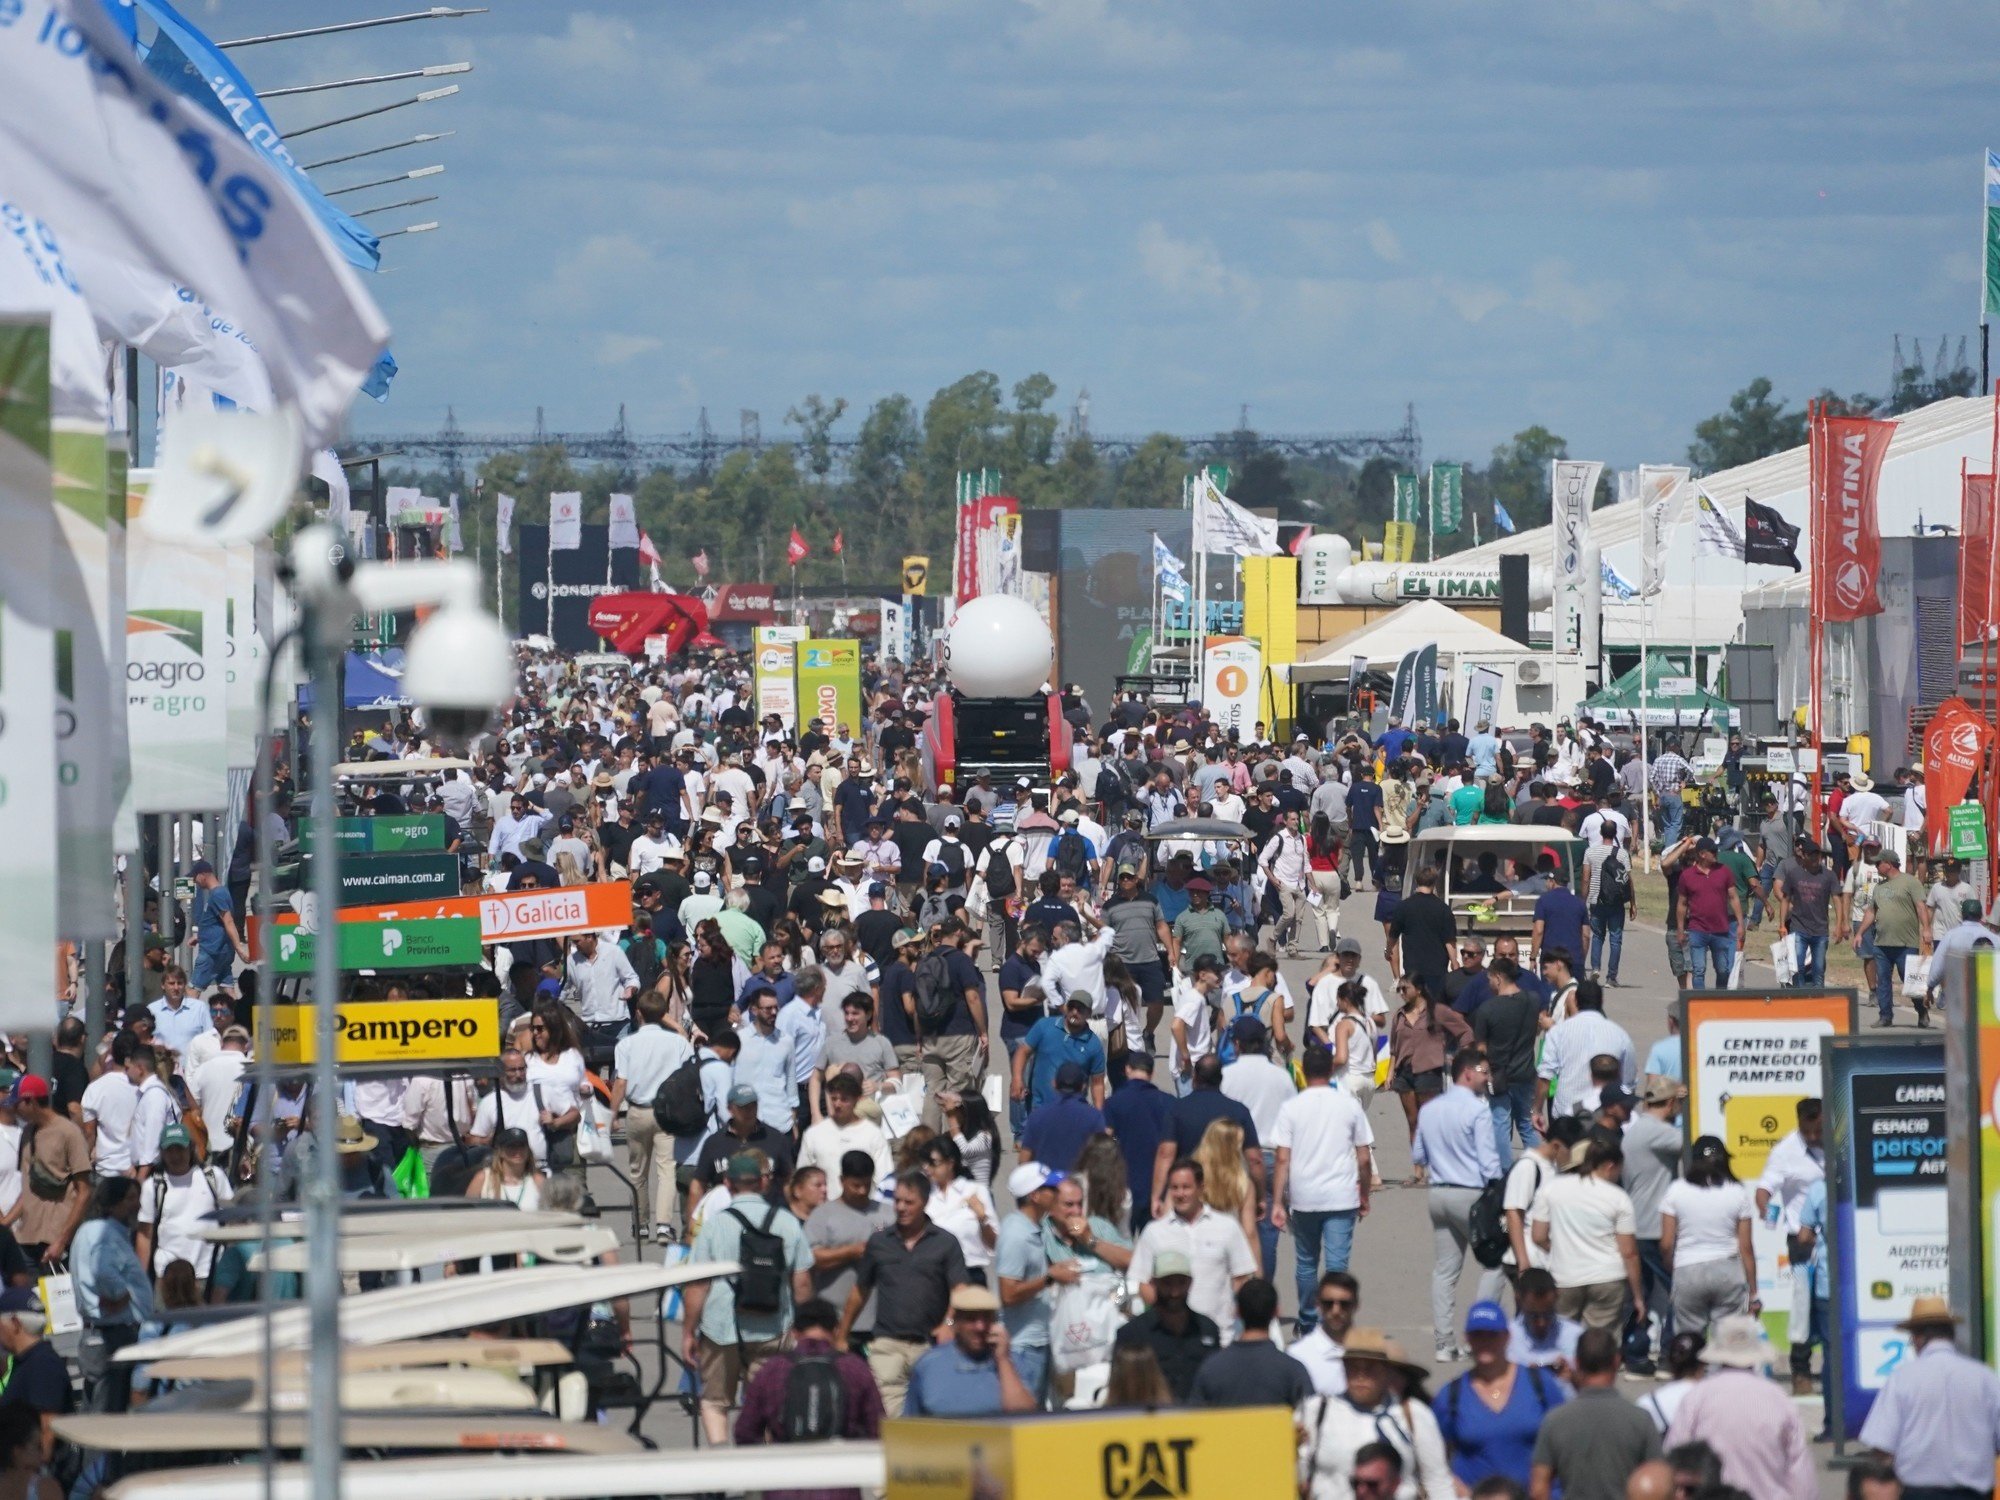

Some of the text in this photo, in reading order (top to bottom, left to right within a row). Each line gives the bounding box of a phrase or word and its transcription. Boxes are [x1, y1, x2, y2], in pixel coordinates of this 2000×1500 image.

[1843, 433, 1866, 555] ALTINA
[1566, 465, 1585, 550] AGTECH
[1226, 672, 1237, 692] 1
[153, 696, 206, 717] agro
[405, 825, 428, 839] agro
[343, 872, 446, 887] www.caiman.com.ar
[515, 898, 581, 925] Galicia
[331, 1014, 478, 1047] Pampero
[1724, 1039, 1809, 1050] CENTRO DE
[1729, 1070, 1805, 1082] PAMPERO
[1872, 1118, 1930, 1135] ESPACIO
[1103, 1437, 1197, 1499] CAT
